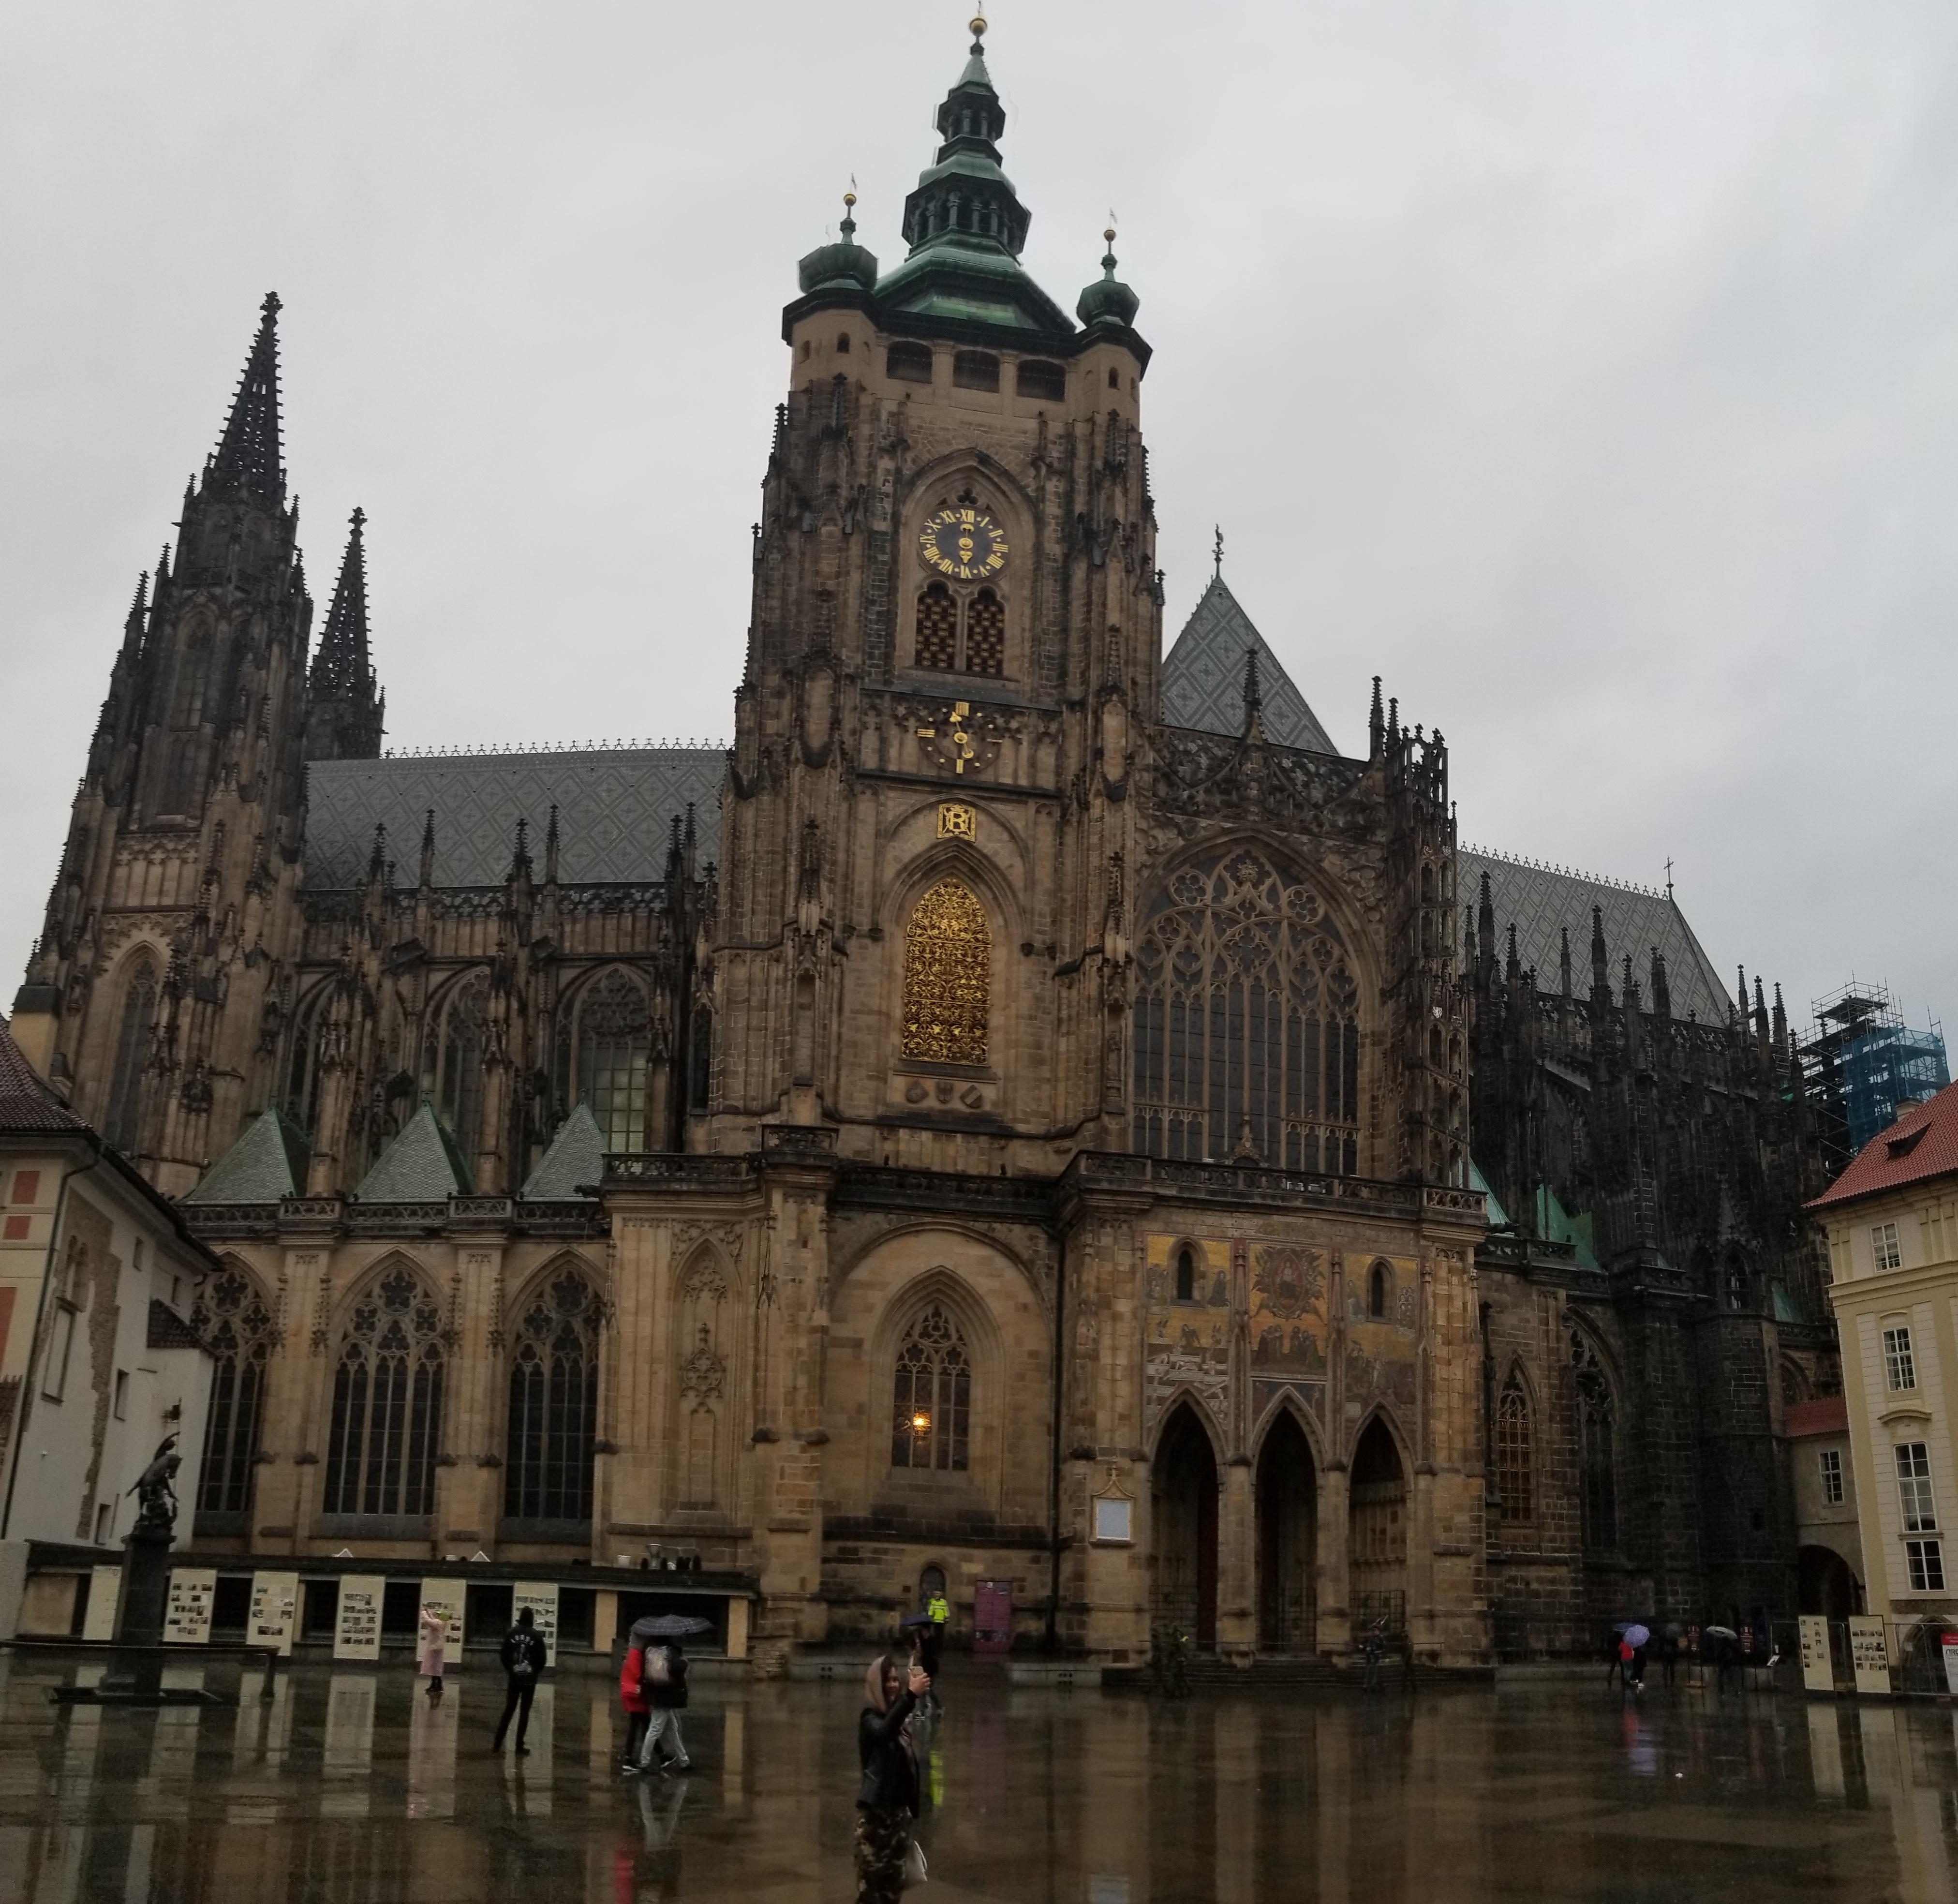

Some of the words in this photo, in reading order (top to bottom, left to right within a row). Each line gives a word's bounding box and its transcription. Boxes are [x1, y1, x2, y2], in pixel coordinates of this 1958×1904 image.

[939, 510, 956, 523] XI
[960, 509, 975, 522] XII
[924, 519, 941, 531] X
[979, 517, 990, 527] I
[920, 534, 935, 543] IX
[989, 529, 1004, 537] II
[993, 543, 1009, 552] III
[922, 547, 940, 564] VIII
[986, 554, 1005, 569] IIII
[938, 559, 953, 575] VII
[961, 565, 972, 579] VI
[979, 565, 990, 577] V
